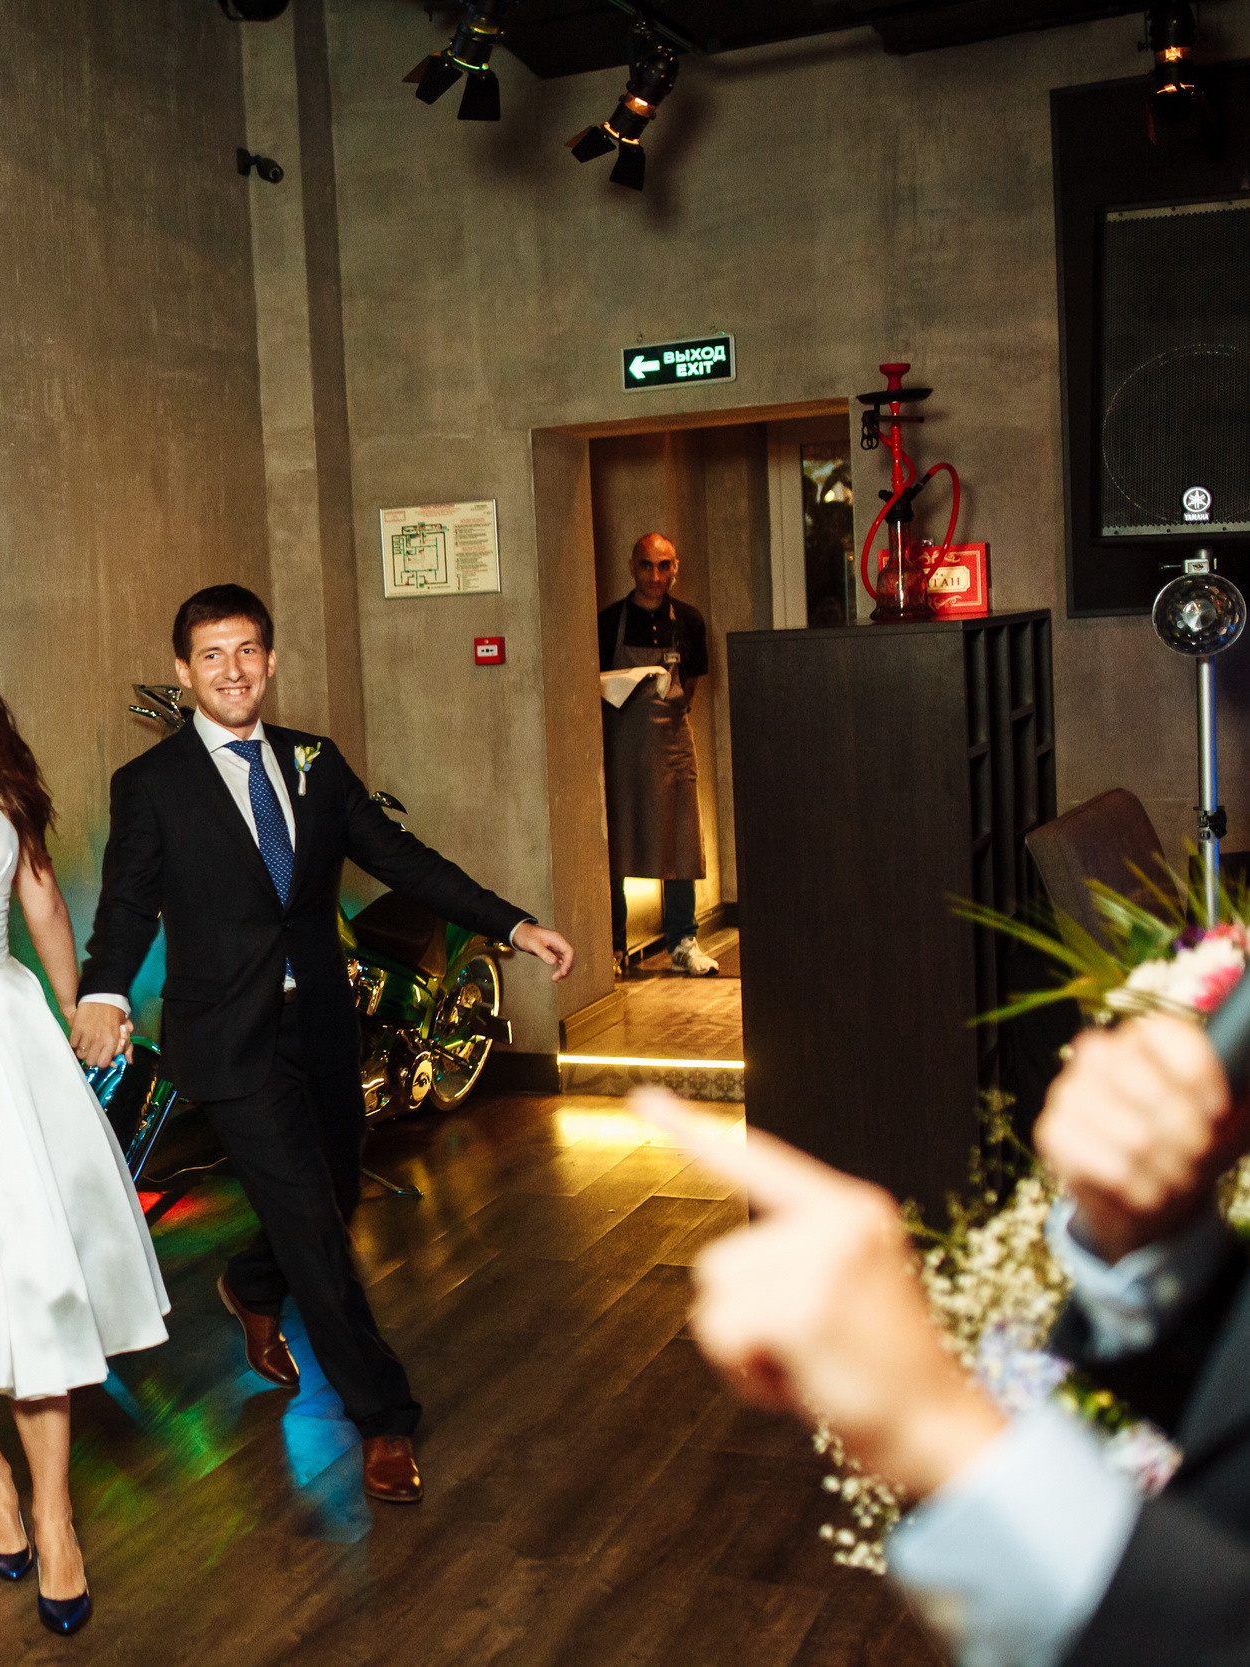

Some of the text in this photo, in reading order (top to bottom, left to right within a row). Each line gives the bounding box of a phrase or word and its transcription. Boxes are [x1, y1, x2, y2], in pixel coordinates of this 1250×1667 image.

[663, 345, 726, 365] ВЫХОД
[676, 360, 714, 378] EXIT
[1183, 512, 1210, 522] YAMAHA
